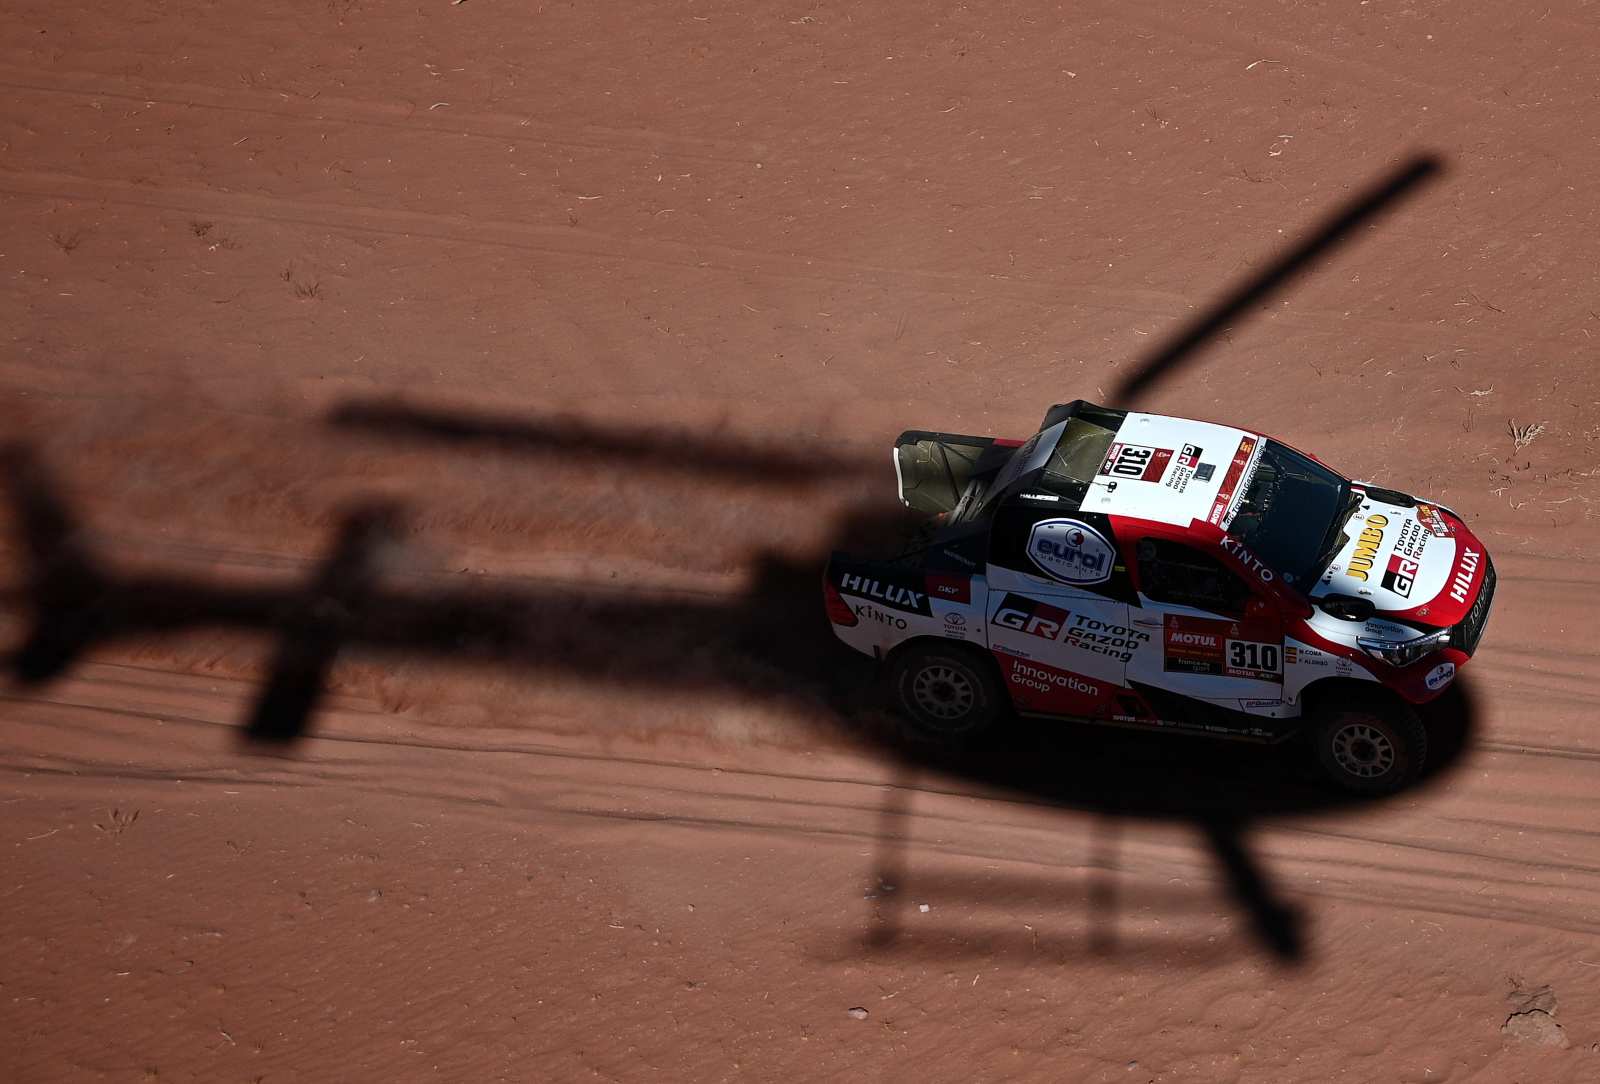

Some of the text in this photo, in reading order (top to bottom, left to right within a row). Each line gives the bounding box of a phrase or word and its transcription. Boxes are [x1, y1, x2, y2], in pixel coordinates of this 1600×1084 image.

[1113, 448, 1151, 476] 310
[1178, 444, 1196, 466] GR
[1210, 503, 1223, 524] MOTUL
[1346, 514, 1389, 582] JUMBO
[1394, 518, 1413, 551] TOYOTA
[1404, 524, 1421, 556] GAZOO
[1413, 529, 1431, 560] Racing
[1038, 539, 1105, 571] eurol
[840, 572, 927, 609] HILUX
[1393, 560, 1419, 598] GR
[1450, 547, 1480, 604] HILUX
[994, 606, 1060, 640] GR
[1068, 627, 1139, 650] GAZOO
[1075, 614, 1150, 642] TOYOTA
[1064, 636, 1133, 662] Racing
[1170, 631, 1217, 647] MOTUL
[1230, 641, 1278, 672] 310
[1010, 673, 1051, 694] Group
[1012, 660, 1099, 697] Innovation
